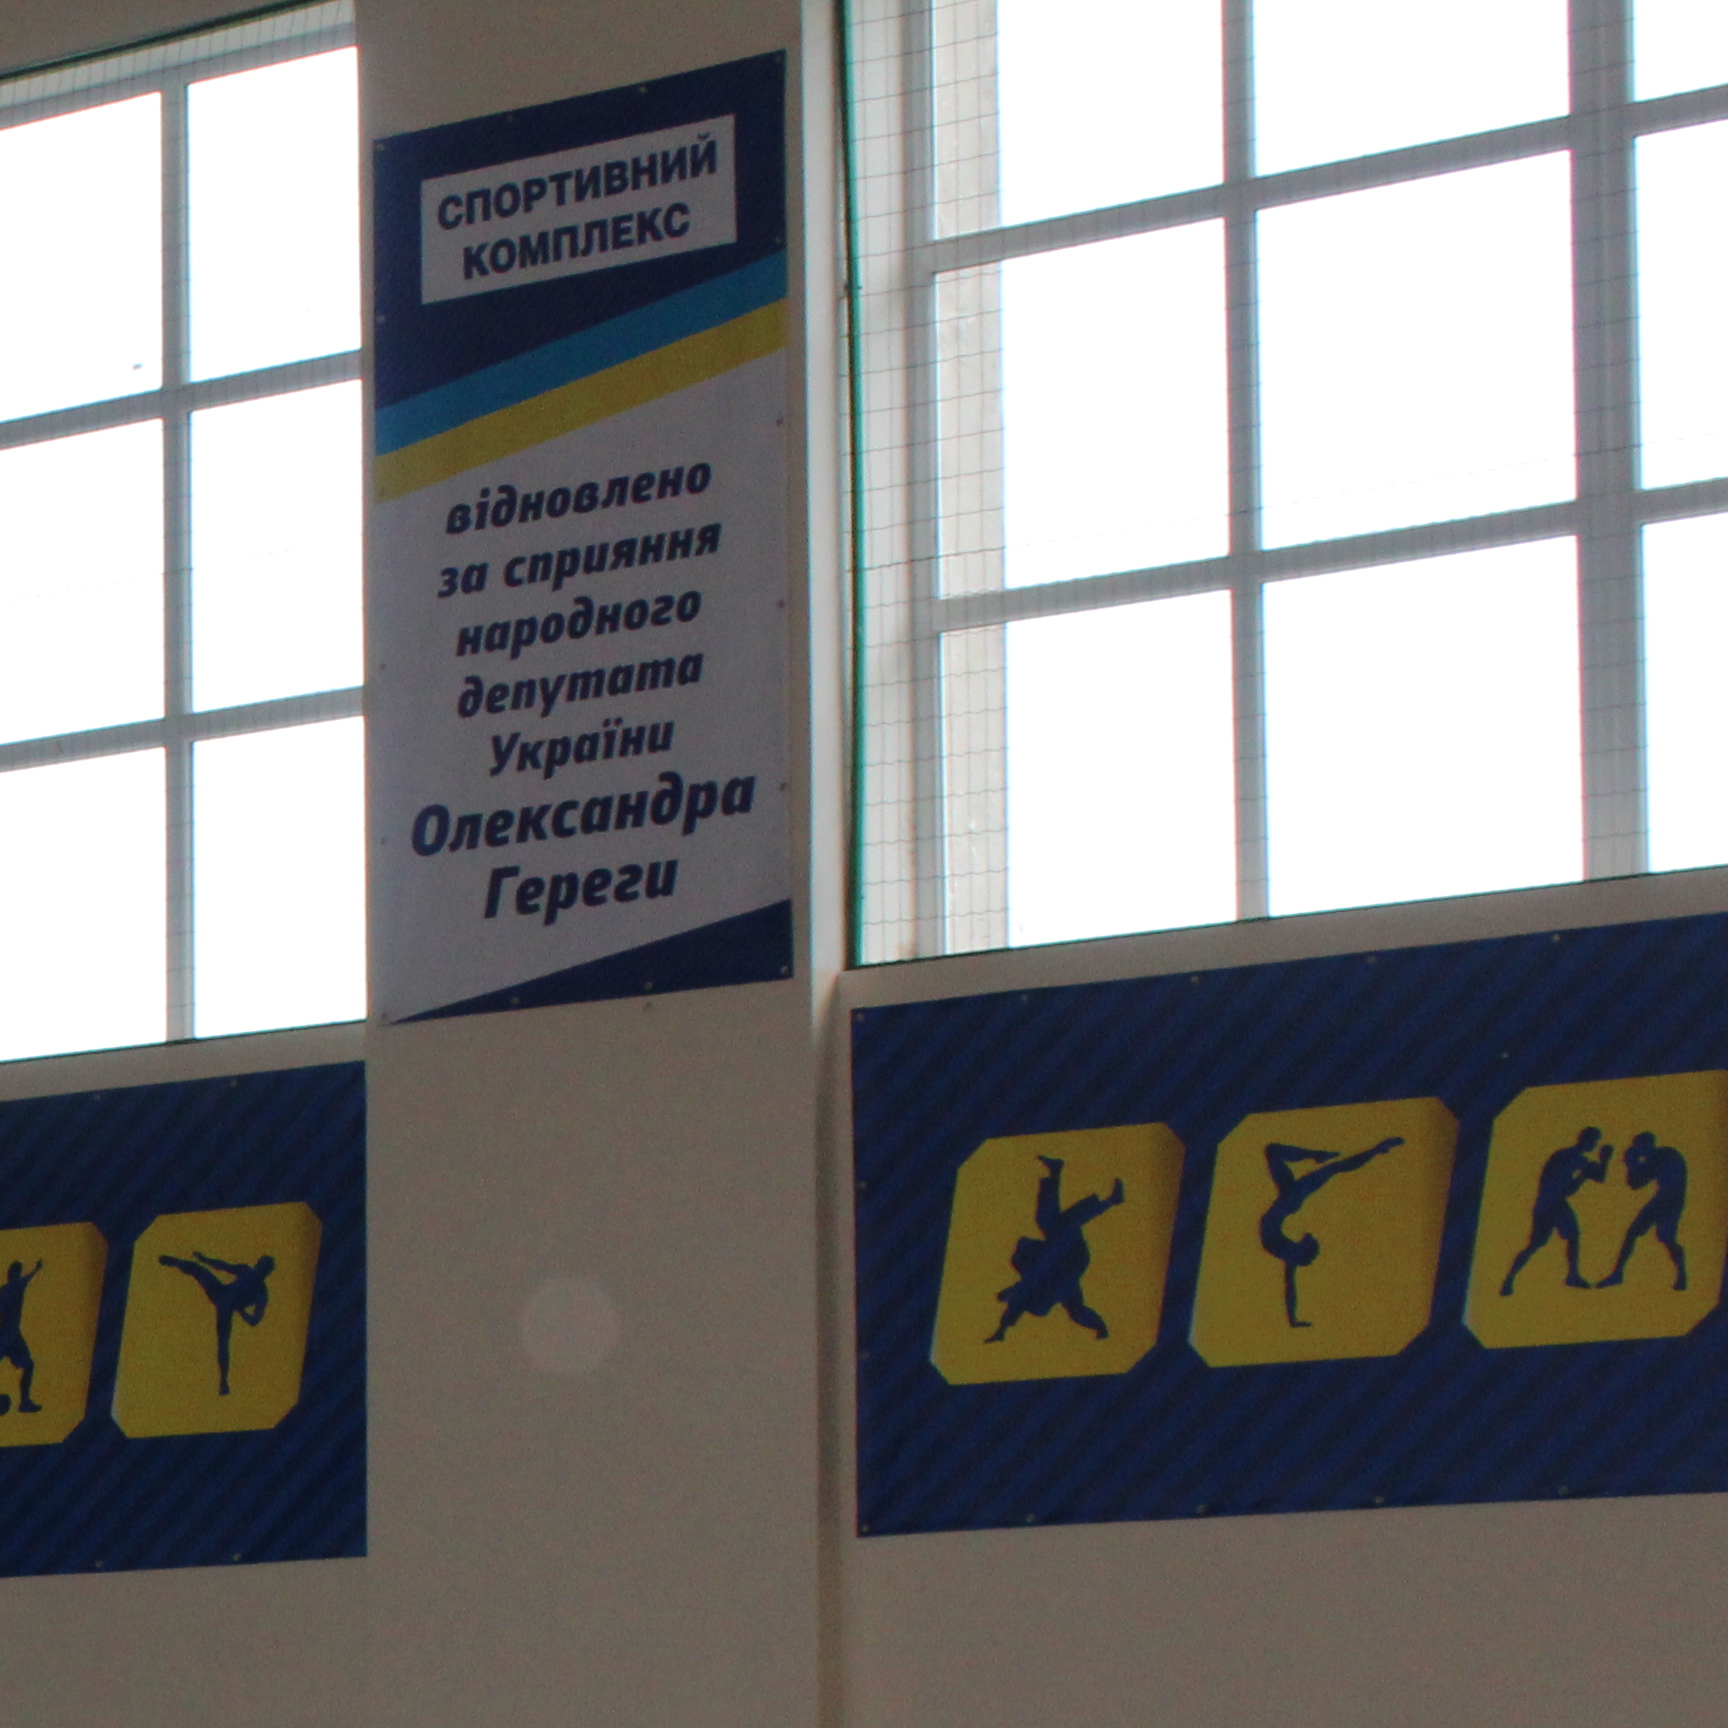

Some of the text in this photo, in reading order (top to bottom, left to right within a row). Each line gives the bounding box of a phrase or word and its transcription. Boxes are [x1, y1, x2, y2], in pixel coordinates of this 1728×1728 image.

[438, 133, 718, 230] СПОРТИВНИЙ
[463, 202, 691, 280] КОМПЛЕКС
[445, 462, 712, 535] відновлено
[437, 522, 722, 599] за сприяння
[456, 590, 702, 660] народного
[457, 652, 704, 718] депутата
[490, 717, 675, 780] України
[411, 771, 756, 857] Олександра
[483, 858, 680, 927] Гереги
